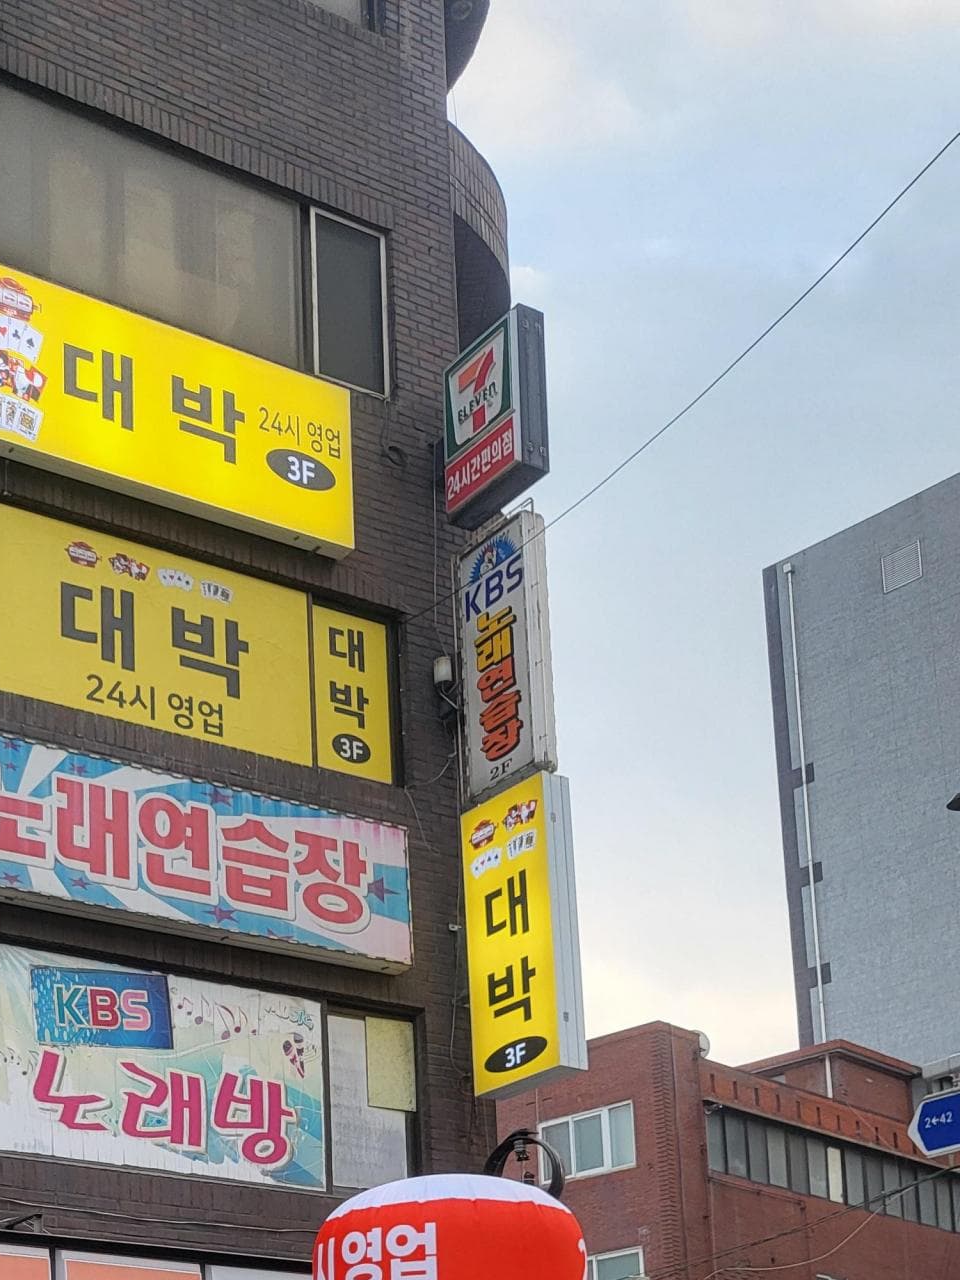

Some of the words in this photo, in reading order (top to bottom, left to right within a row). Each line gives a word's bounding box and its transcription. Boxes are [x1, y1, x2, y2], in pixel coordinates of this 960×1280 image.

[63, 343, 246, 465] 대박
[258, 407, 302, 445] 24시
[306, 424, 342, 460] 영업
[287, 456, 316, 485] 3F
[447, 428, 513, 501] 24시간편의점
[465, 553, 525, 621] KBS
[60, 581, 249, 699] 대박
[86, 674, 157, 721] 24시
[167, 692, 224, 738] 영업
[328, 627, 369, 730] 대박
[474, 605, 523, 762] 노래연습장
[339, 738, 365, 761] 3F
[490, 757, 514, 782] 2F
[483, 868, 537, 1023] 대박
[53, 983, 153, 1032] KBS
[505, 1042, 527, 1069] 3F
[33, 1050, 294, 1166] 노래방
